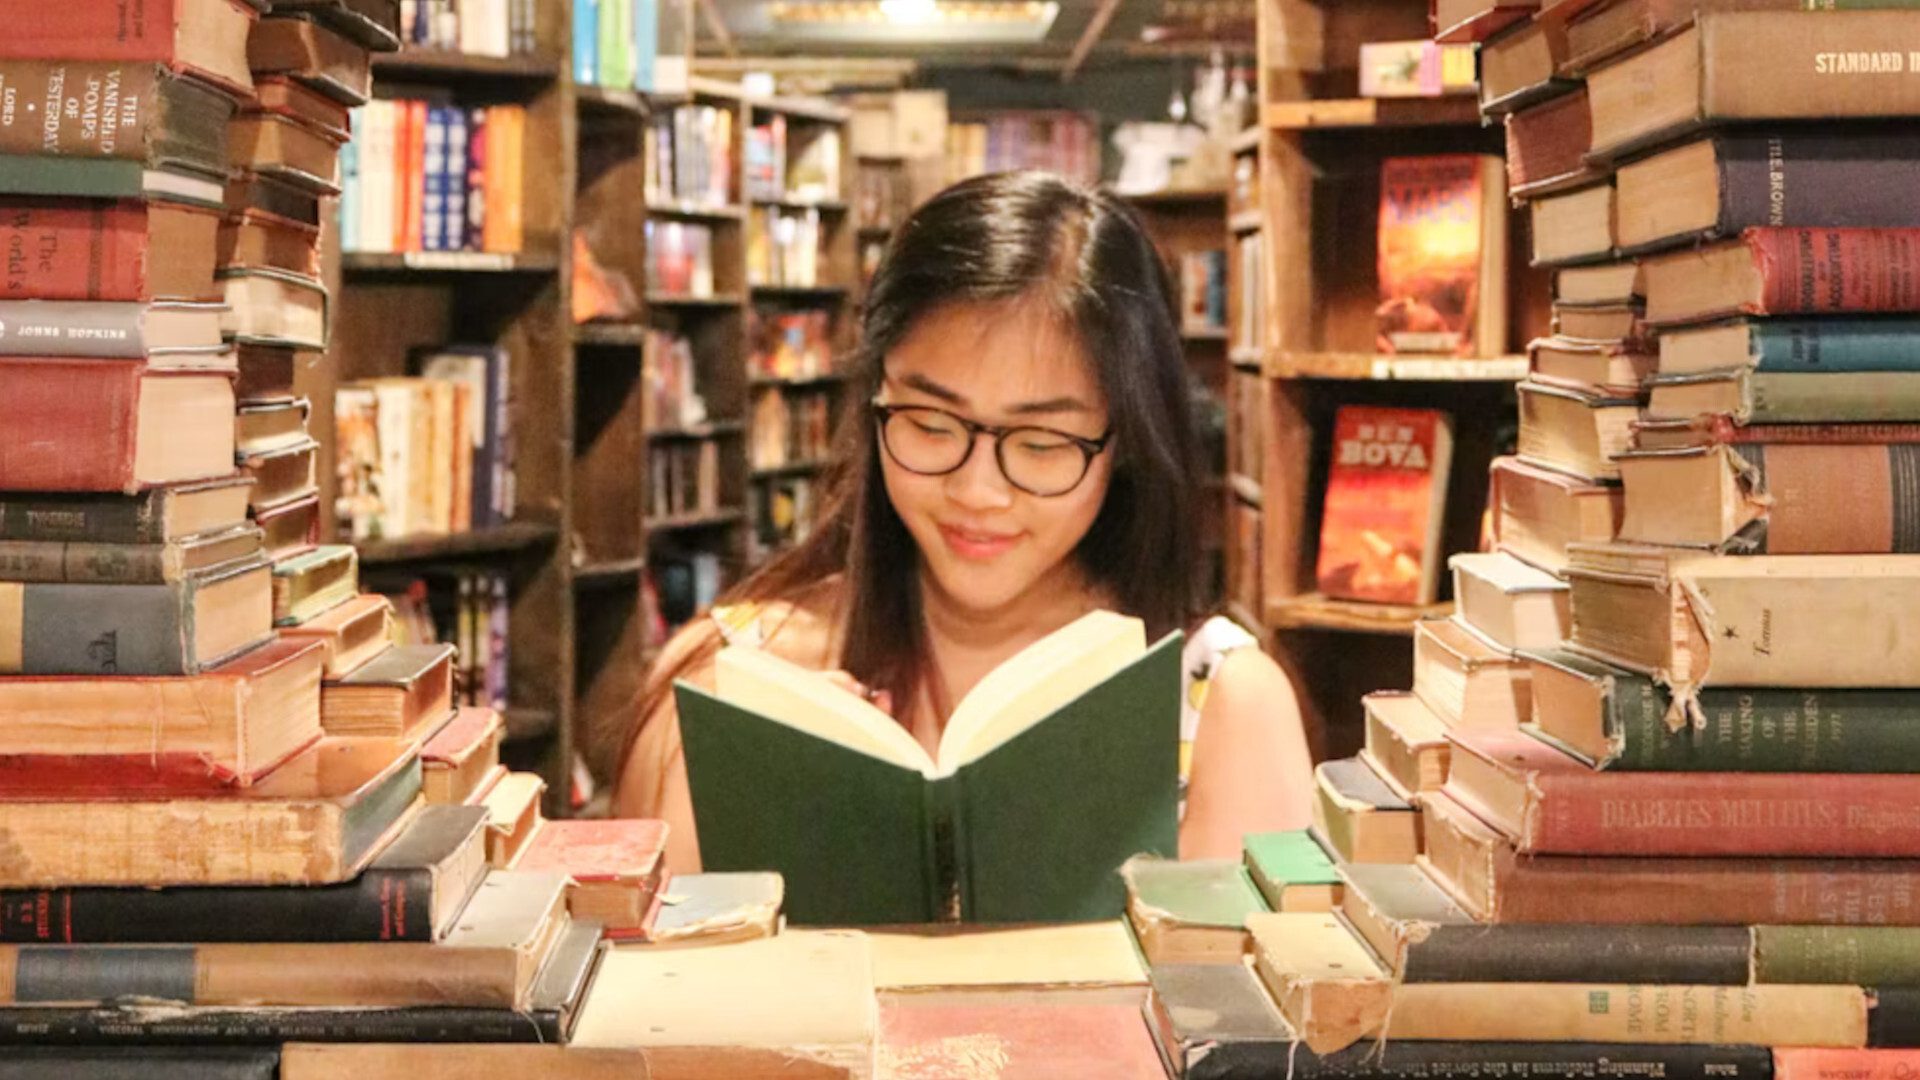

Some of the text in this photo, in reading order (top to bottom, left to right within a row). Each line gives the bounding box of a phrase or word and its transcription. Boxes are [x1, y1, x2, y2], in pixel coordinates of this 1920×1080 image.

[1815, 52, 1903, 73] STANDARD
[2, 87, 16, 126] LORD
[65, 97, 79, 119] OF
[81, 80, 101, 139] POMPS
[101, 70, 121, 154] VANISHED
[121, 94, 138, 127] THE
[1769, 172, 1784, 226] BROWN
[39, 234, 58, 274] The
[18, 325, 60, 337] JOHNS
[67, 327, 127, 339] HOPKINS
[1338, 441, 1428, 468] BOVA
[1719, 711, 1732, 743] THE
[1762, 715, 1776, 739] OF
[1601, 799, 1712, 829] DIABETES
[225, 1026, 248, 1035] AND
[1432, 1062, 1479, 1077] Soviet
[1484, 1062, 1508, 1077] the
[1513, 1062, 1528, 1077] in
[1533, 1063, 1595, 1078] Reforms
[1598, 1058, 1666, 1078] Planning
